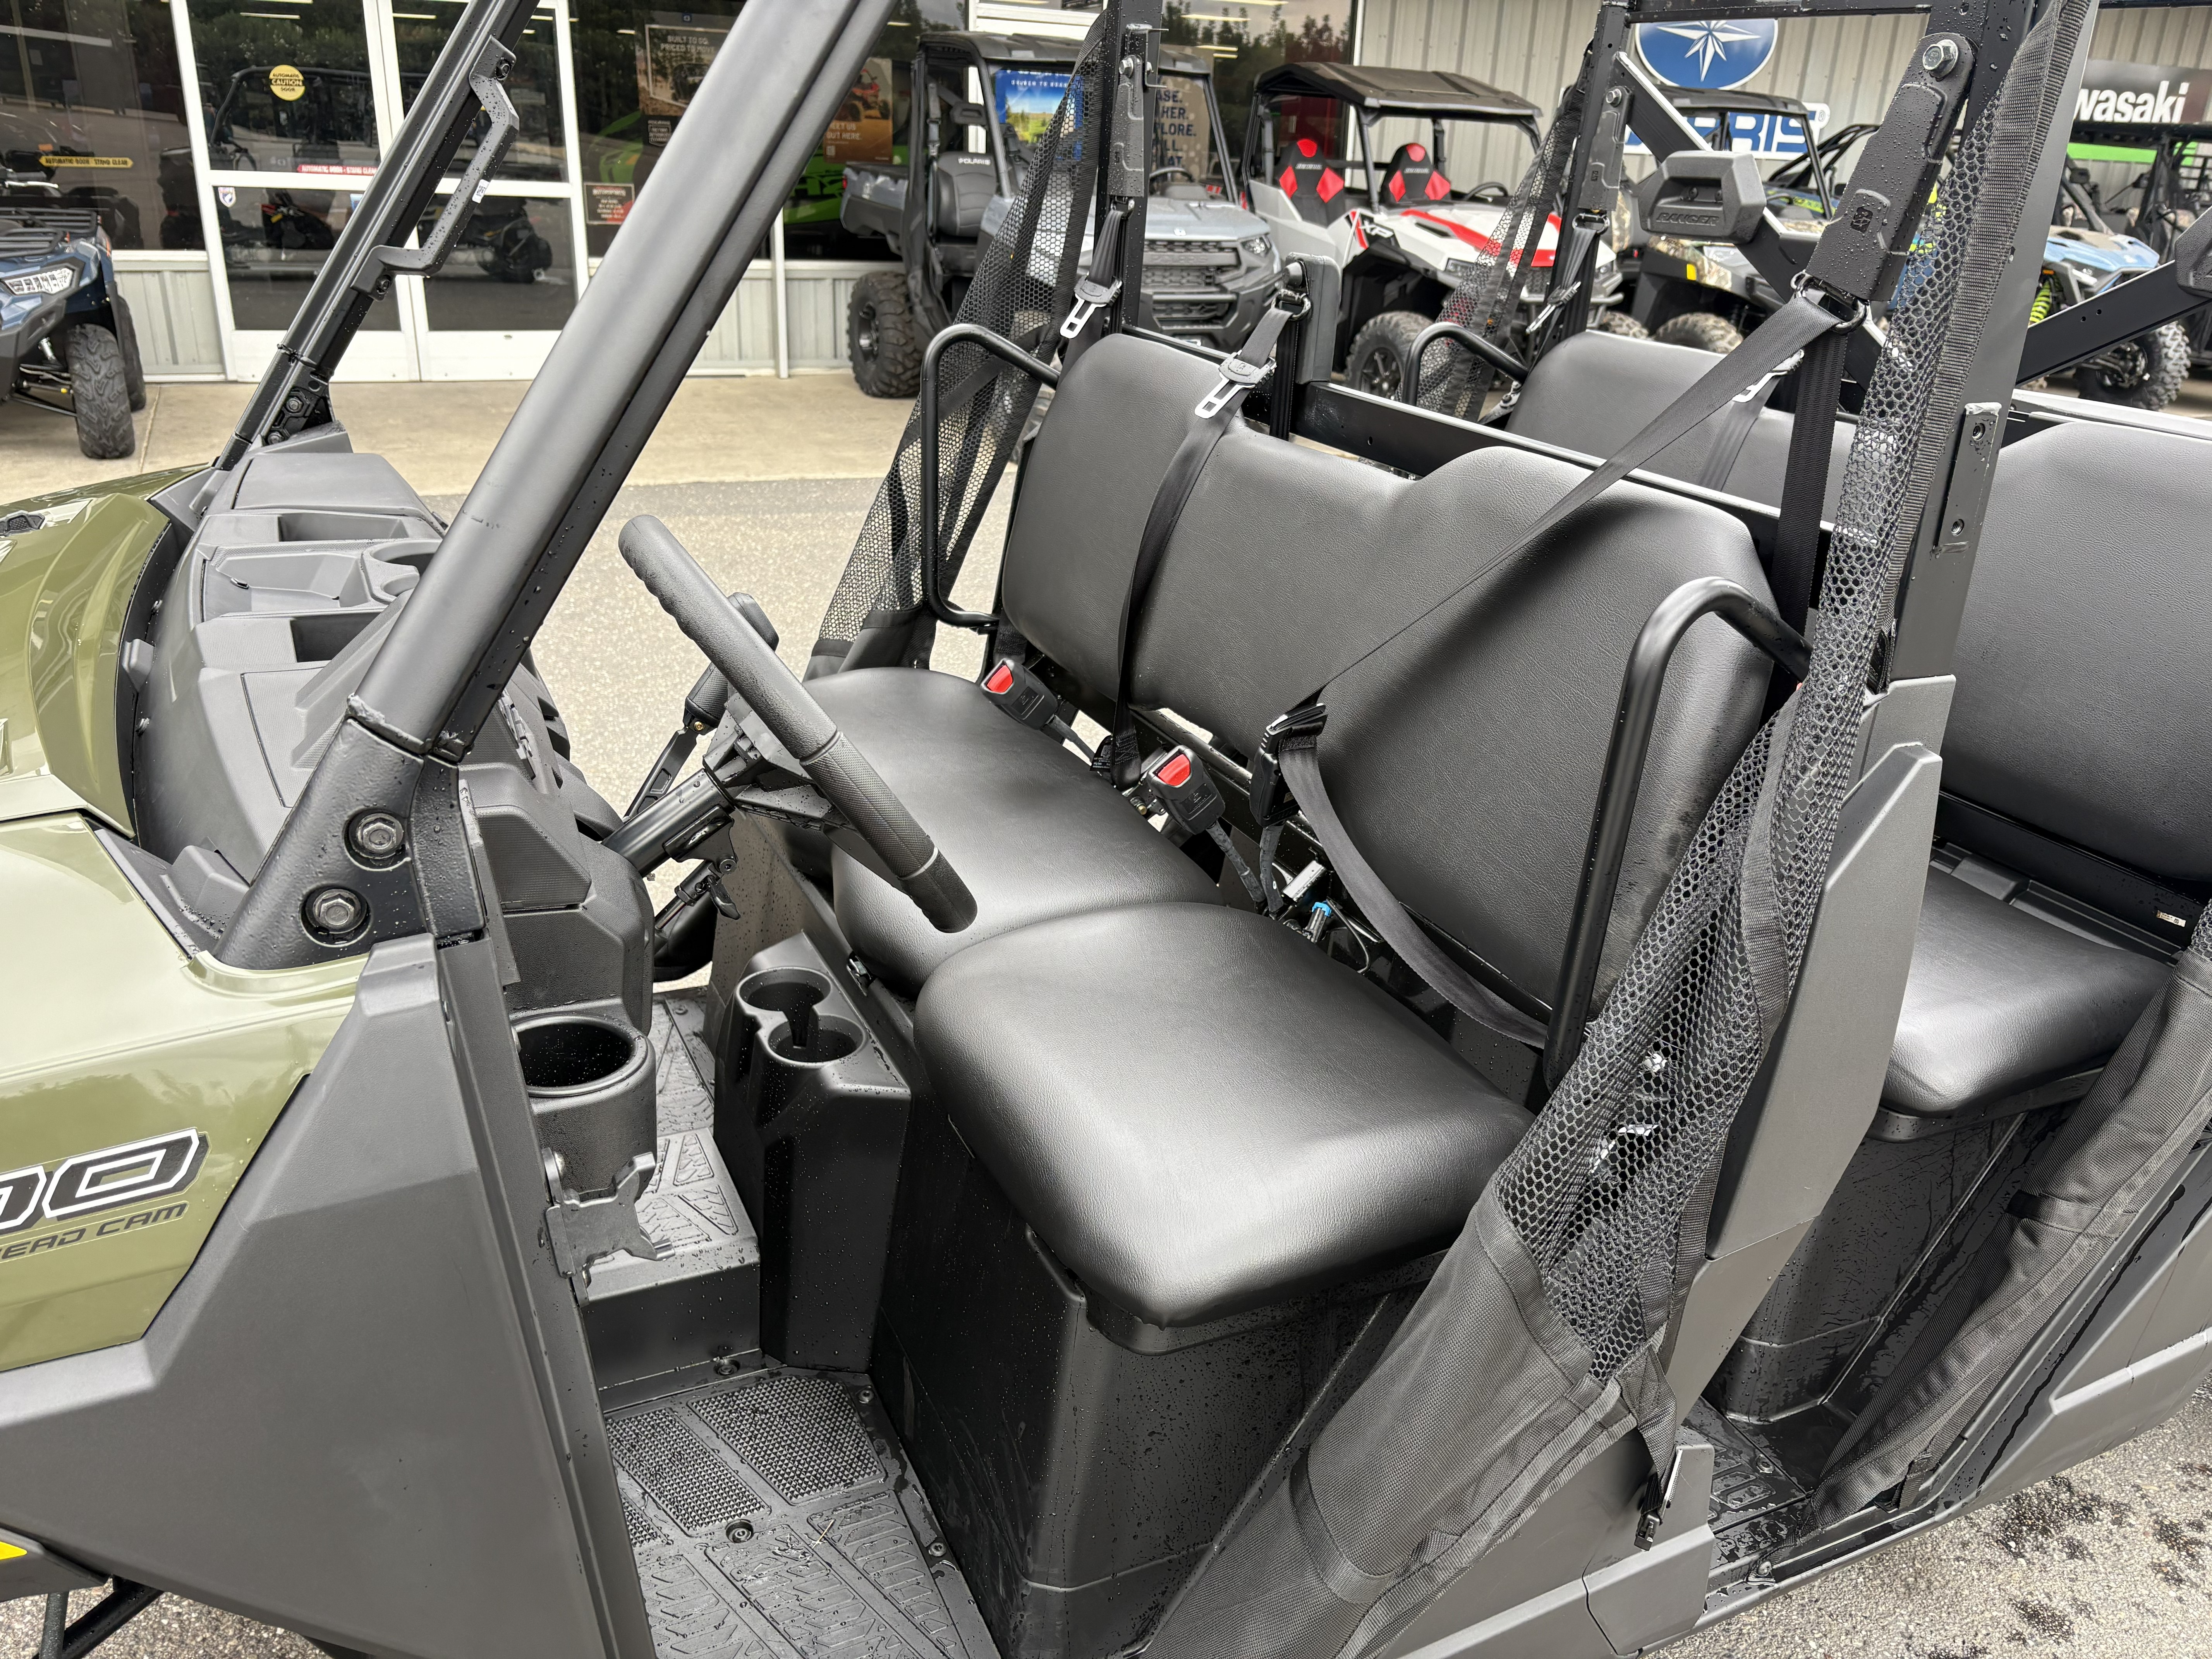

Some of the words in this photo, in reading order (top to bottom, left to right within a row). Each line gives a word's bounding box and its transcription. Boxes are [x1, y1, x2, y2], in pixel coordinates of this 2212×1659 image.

[1656, 212, 1720, 226] RANGER
[1358, 220, 1394, 238] XP
[0, 1228, 86, 1259] EAD
[96, 1203, 189, 1237] CAM
